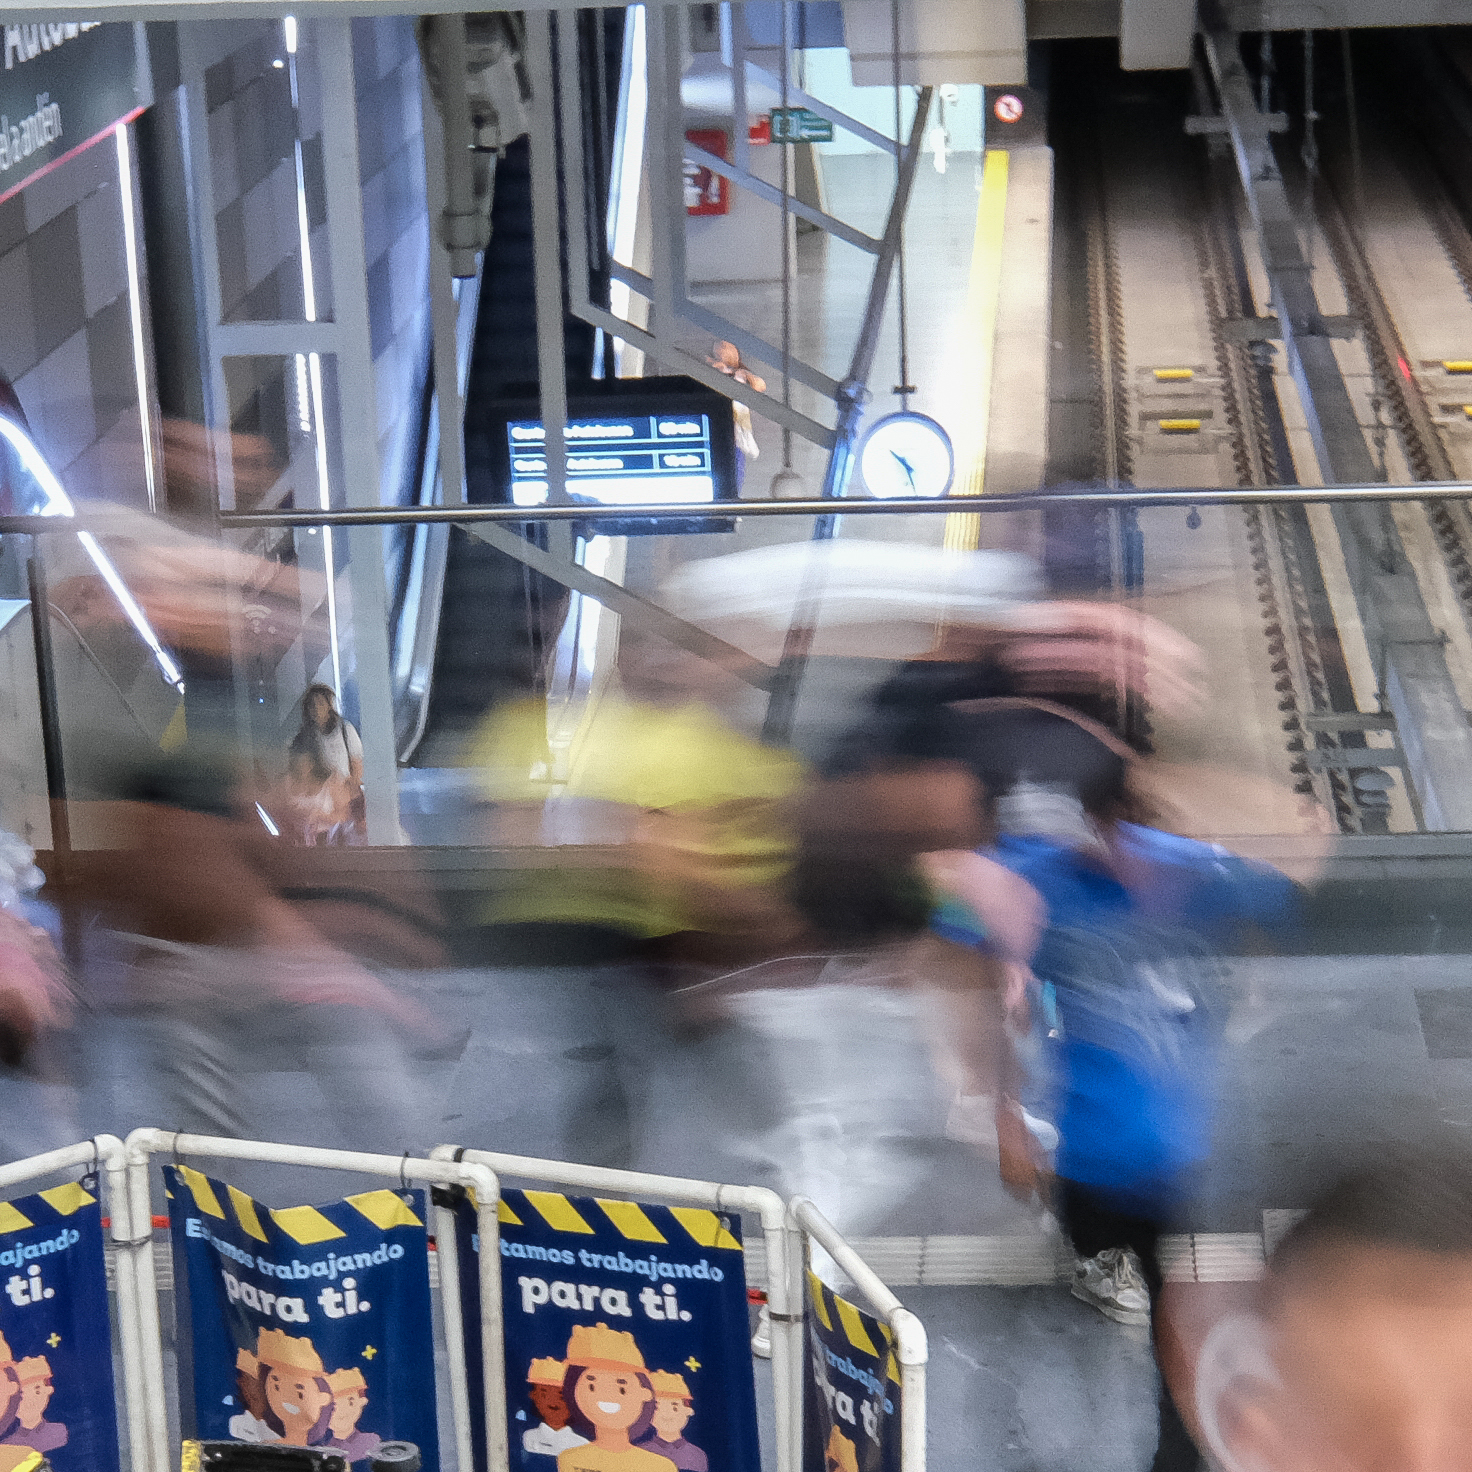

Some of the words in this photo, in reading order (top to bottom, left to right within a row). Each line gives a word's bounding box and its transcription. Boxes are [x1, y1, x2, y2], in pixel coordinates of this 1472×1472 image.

[256, 1243, 405, 1281] trabajando
[578, 1249, 724, 1282] trabajando
[5, 1264, 55, 1306] ti.
[221, 1269, 310, 1323] para
[317, 1277, 371, 1319] ti.
[518, 1275, 633, 1317] para
[638, 1283, 692, 1322] ti.
